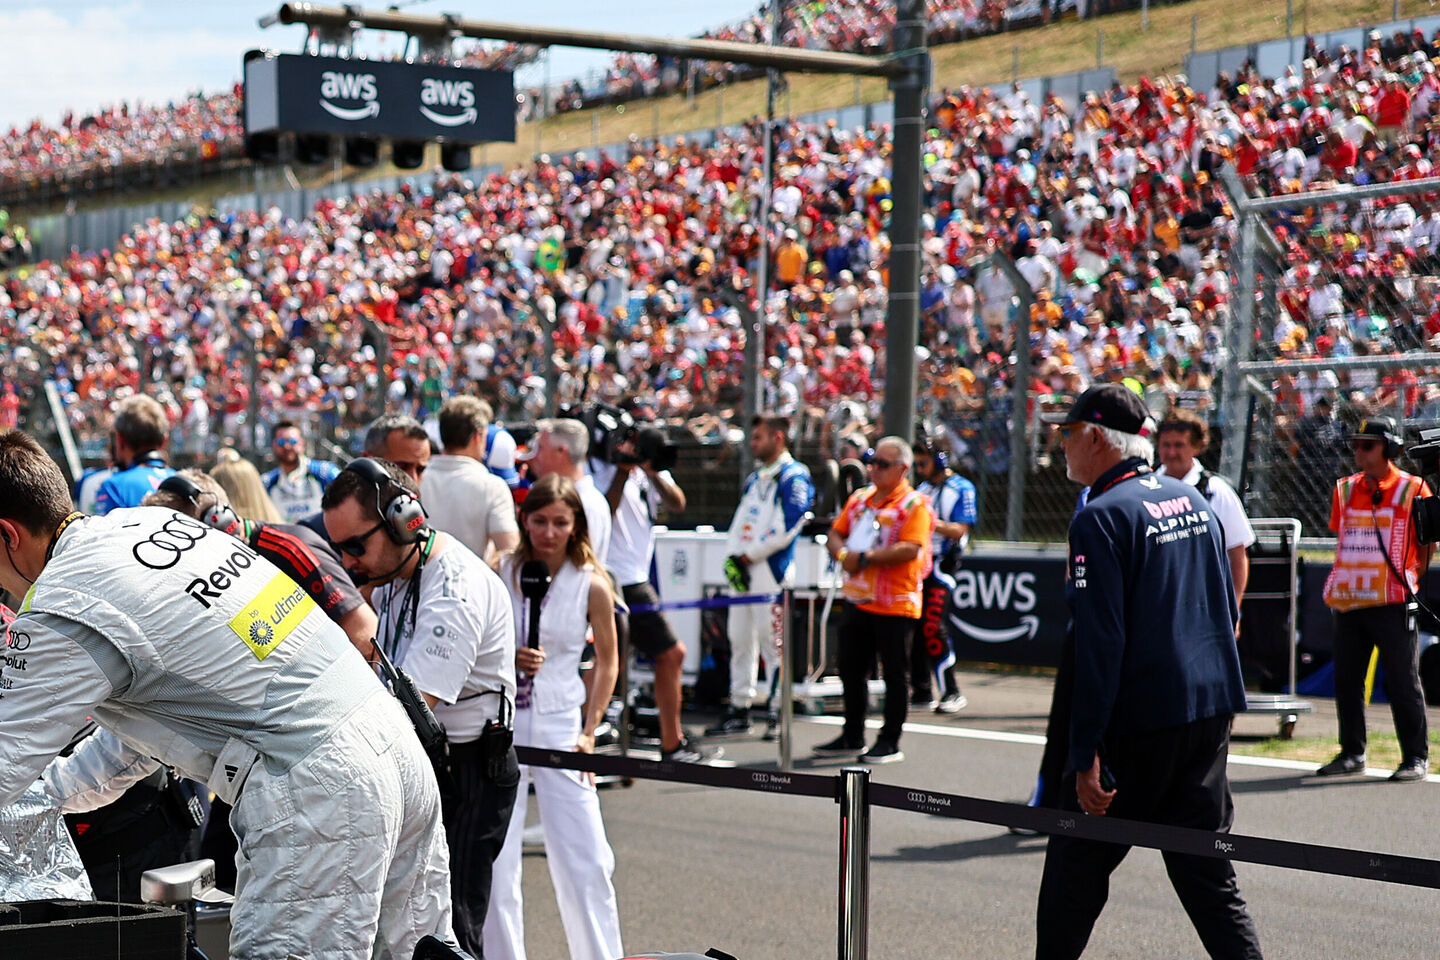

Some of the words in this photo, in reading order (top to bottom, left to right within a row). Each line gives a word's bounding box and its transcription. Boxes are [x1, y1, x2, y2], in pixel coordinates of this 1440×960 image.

[320, 71, 378, 101] aws
[420, 77, 476, 107] aws
[1158, 496, 1193, 517] BWT
[1145, 510, 1210, 537] ALPINE
[1193, 524, 1208, 537] TEAM
[184, 542, 261, 609] Revol
[953, 569, 1037, 612] aws
[248, 608, 260, 620] bp
[770, 774, 792, 785] Revolut
[927, 794, 952, 806] Revolut
